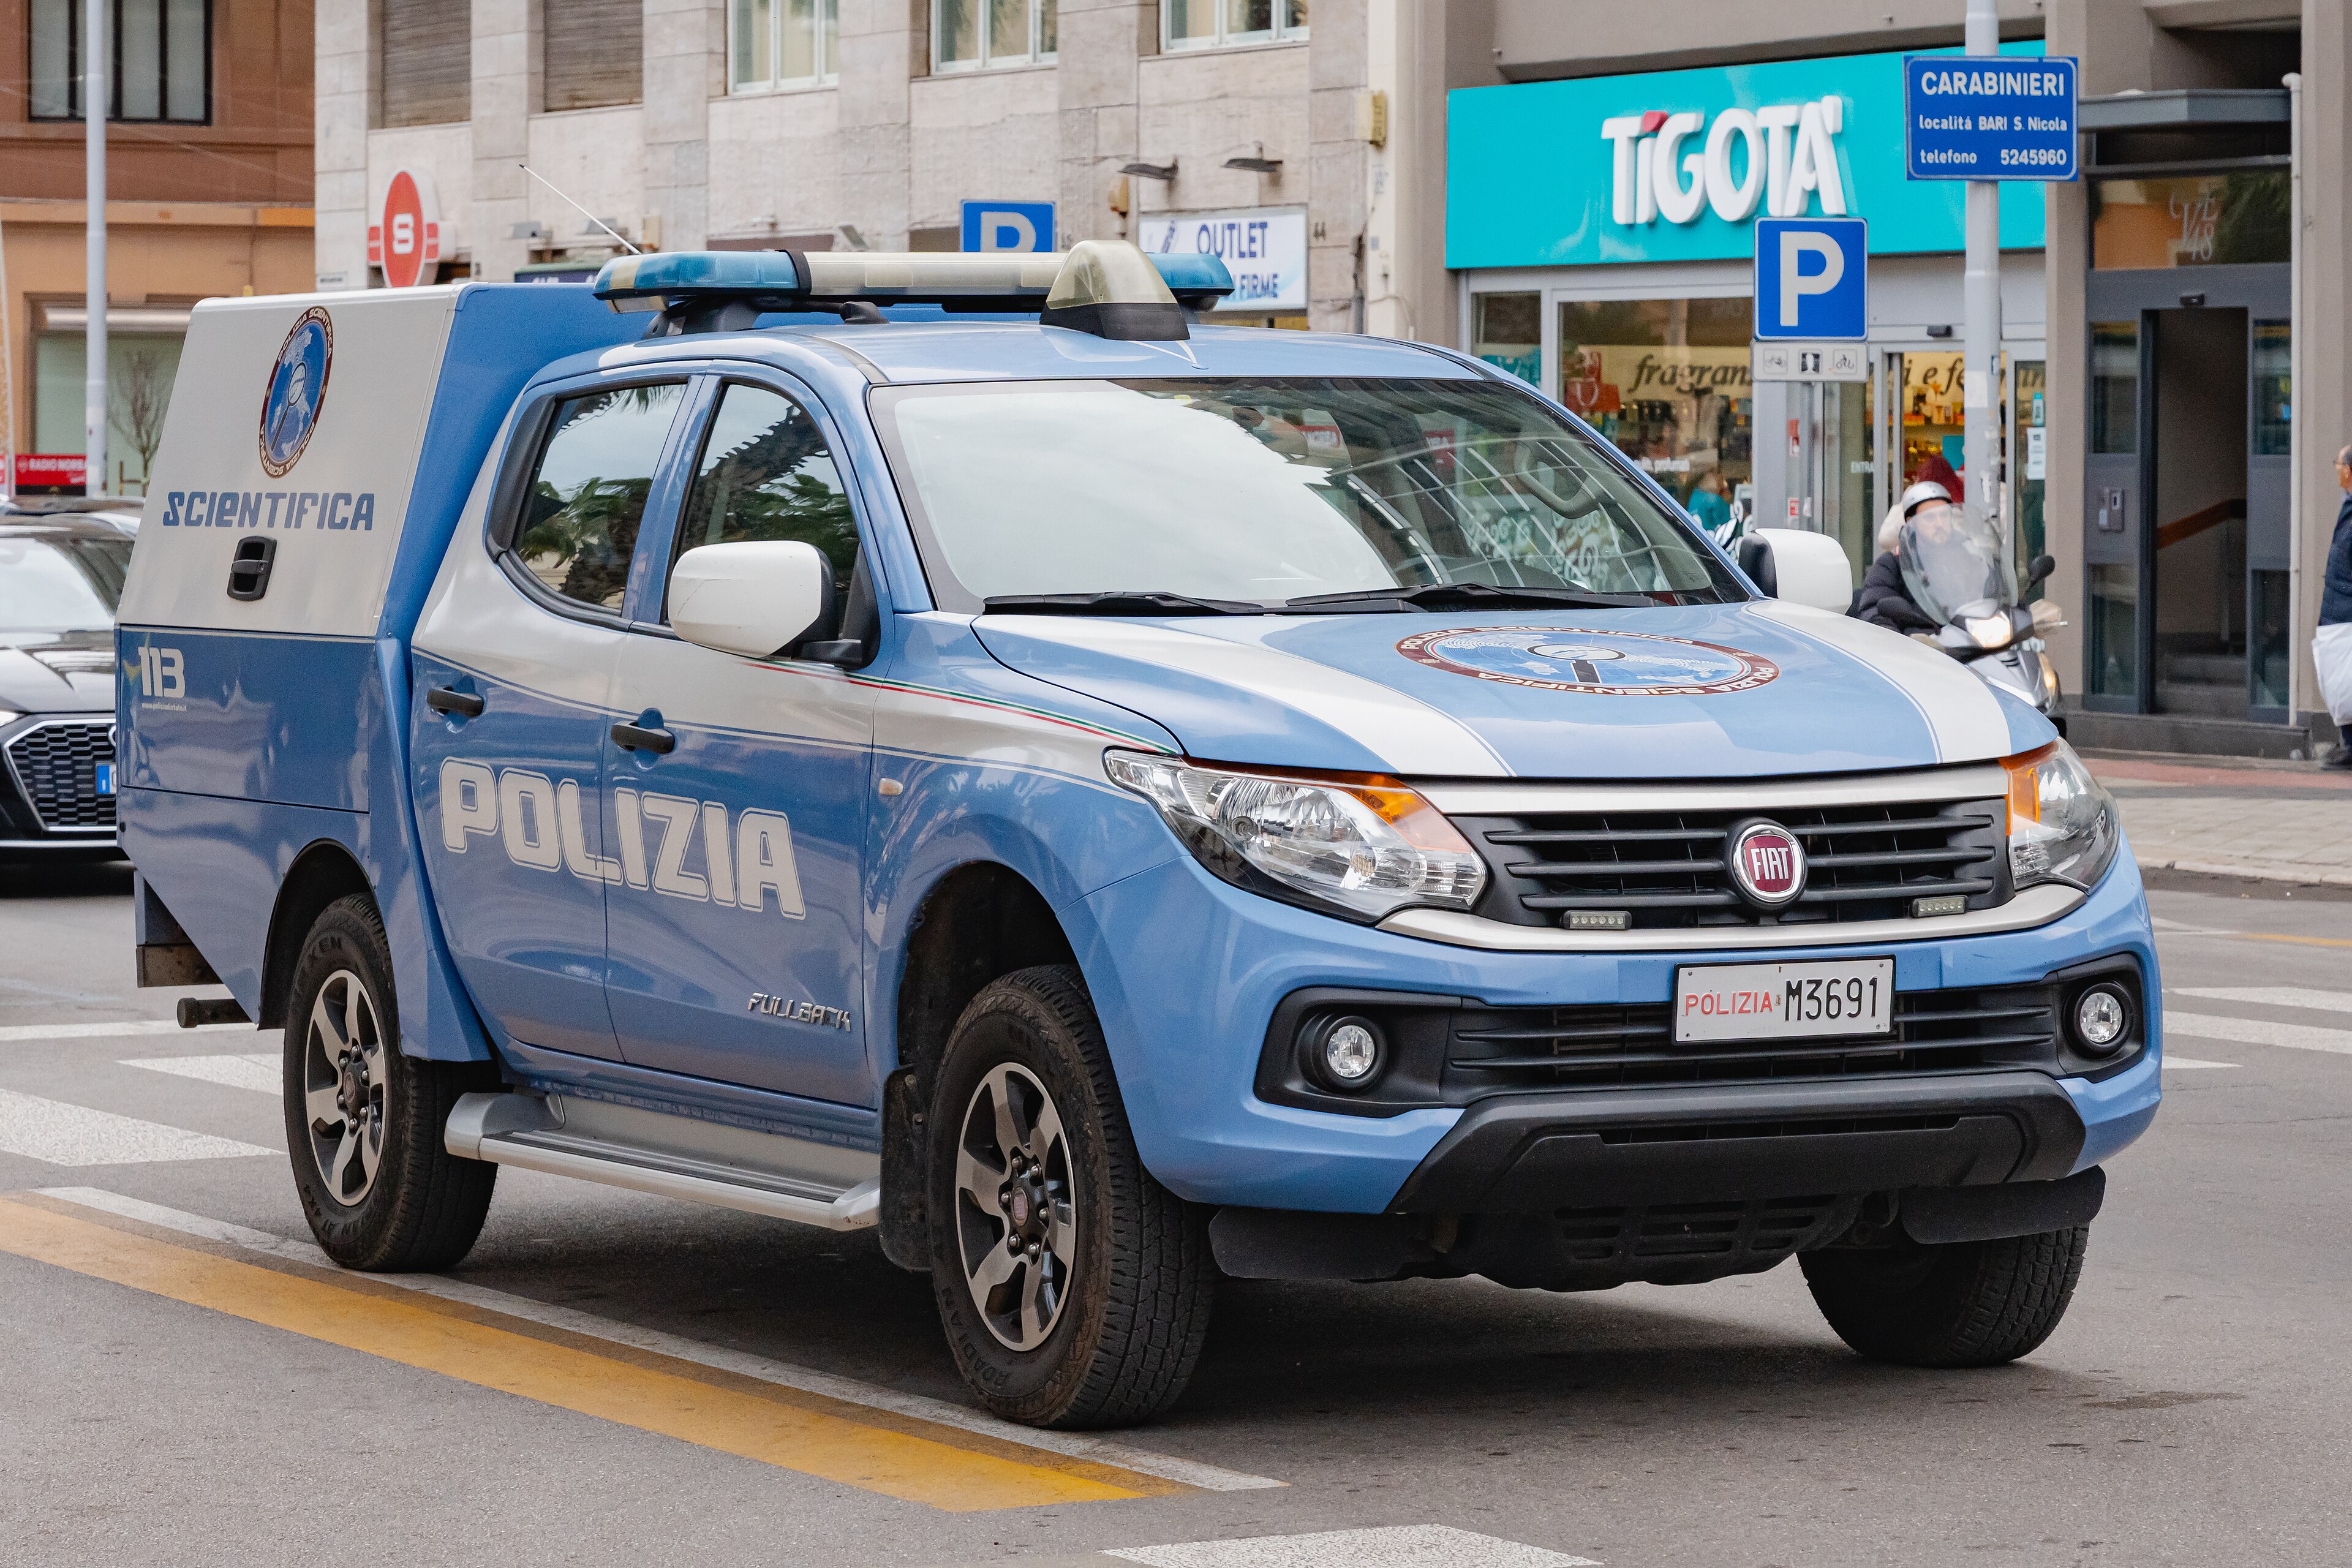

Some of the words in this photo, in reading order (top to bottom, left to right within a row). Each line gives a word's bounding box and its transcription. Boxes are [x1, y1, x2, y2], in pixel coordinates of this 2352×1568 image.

[1921, 71, 2064, 96] CARABINIERI
[1978, 116, 2008, 131] BARI
[2027, 116, 2068, 132] Nicola
[1920, 149, 1977, 164] telefono
[2000, 149, 2067, 165] 5245960
[1197, 222, 1268, 258] OUTLET
[1240, 273, 1278, 298] FIRME
[1779, 232, 1845, 326] P
[278, 314, 307, 362] POLIZIA
[309, 307, 333, 358] SCIENTIFICA
[1401, 628, 1472, 649] POLIZIA
[1474, 626, 1694, 644] SCIENTIFICA
[138, 646, 186, 698] 113
[1478, 672, 1706, 695] SCIENTIFICA
[1707, 666, 1776, 693] POLIZIA
[439, 756, 806, 920] POLIZIA
[1751, 846, 1789, 881] FIAT
[747, 992, 851, 1031] FULLBACK
[1684, 990, 1773, 1017] POLIZIA
[1784, 976, 1878, 1022] M3691
[941, 1287, 1011, 1386] ROADIAN
